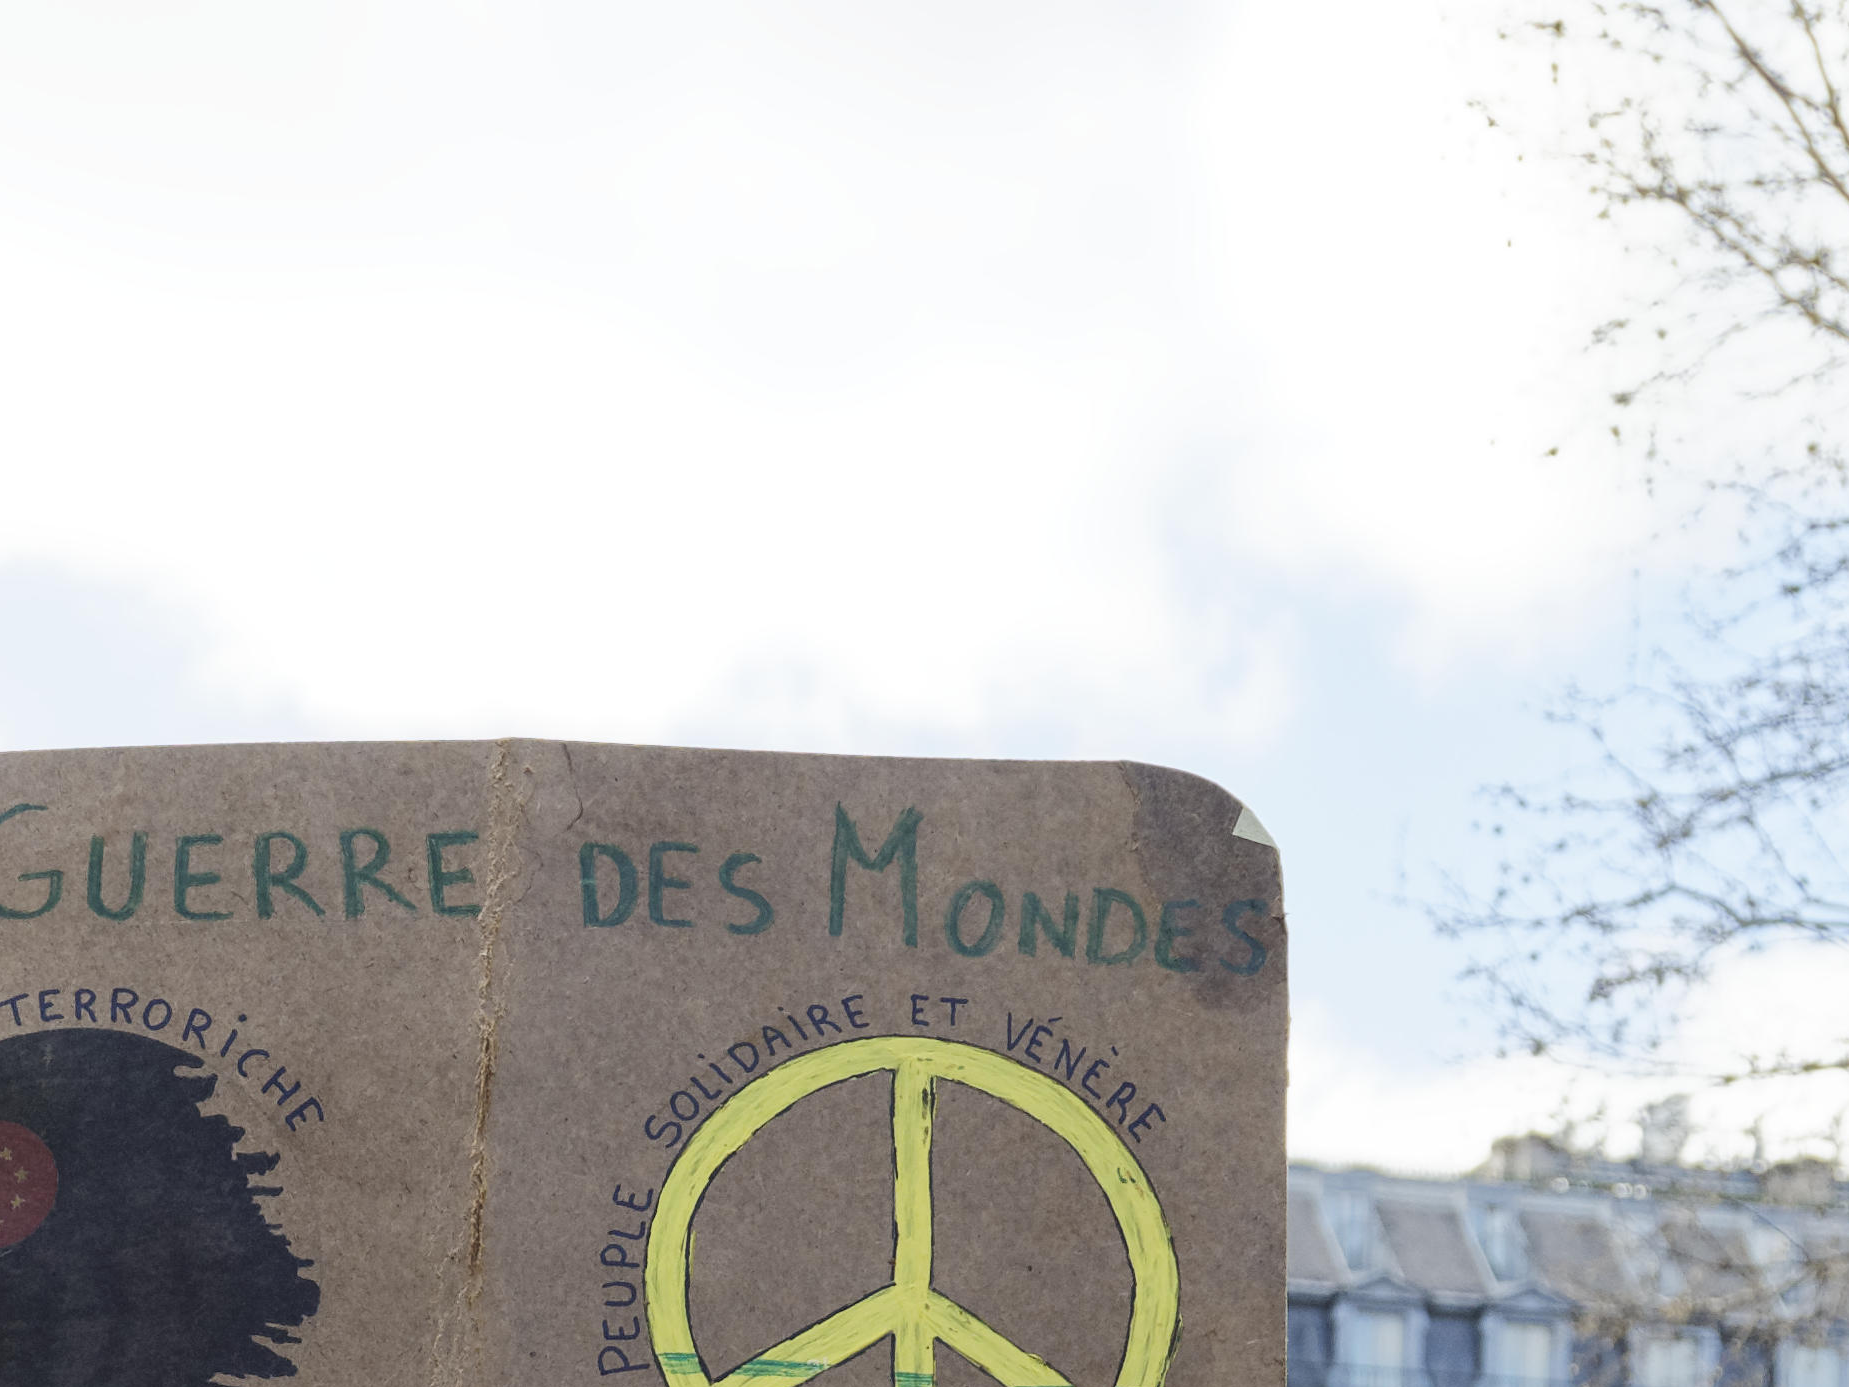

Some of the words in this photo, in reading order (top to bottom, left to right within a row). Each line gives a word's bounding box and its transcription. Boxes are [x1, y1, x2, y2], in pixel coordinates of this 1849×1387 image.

[579, 840, 776, 935] DES
[597, 1182, 655, 1377] PEUPLE
[910, 995, 970, 1028] ET
